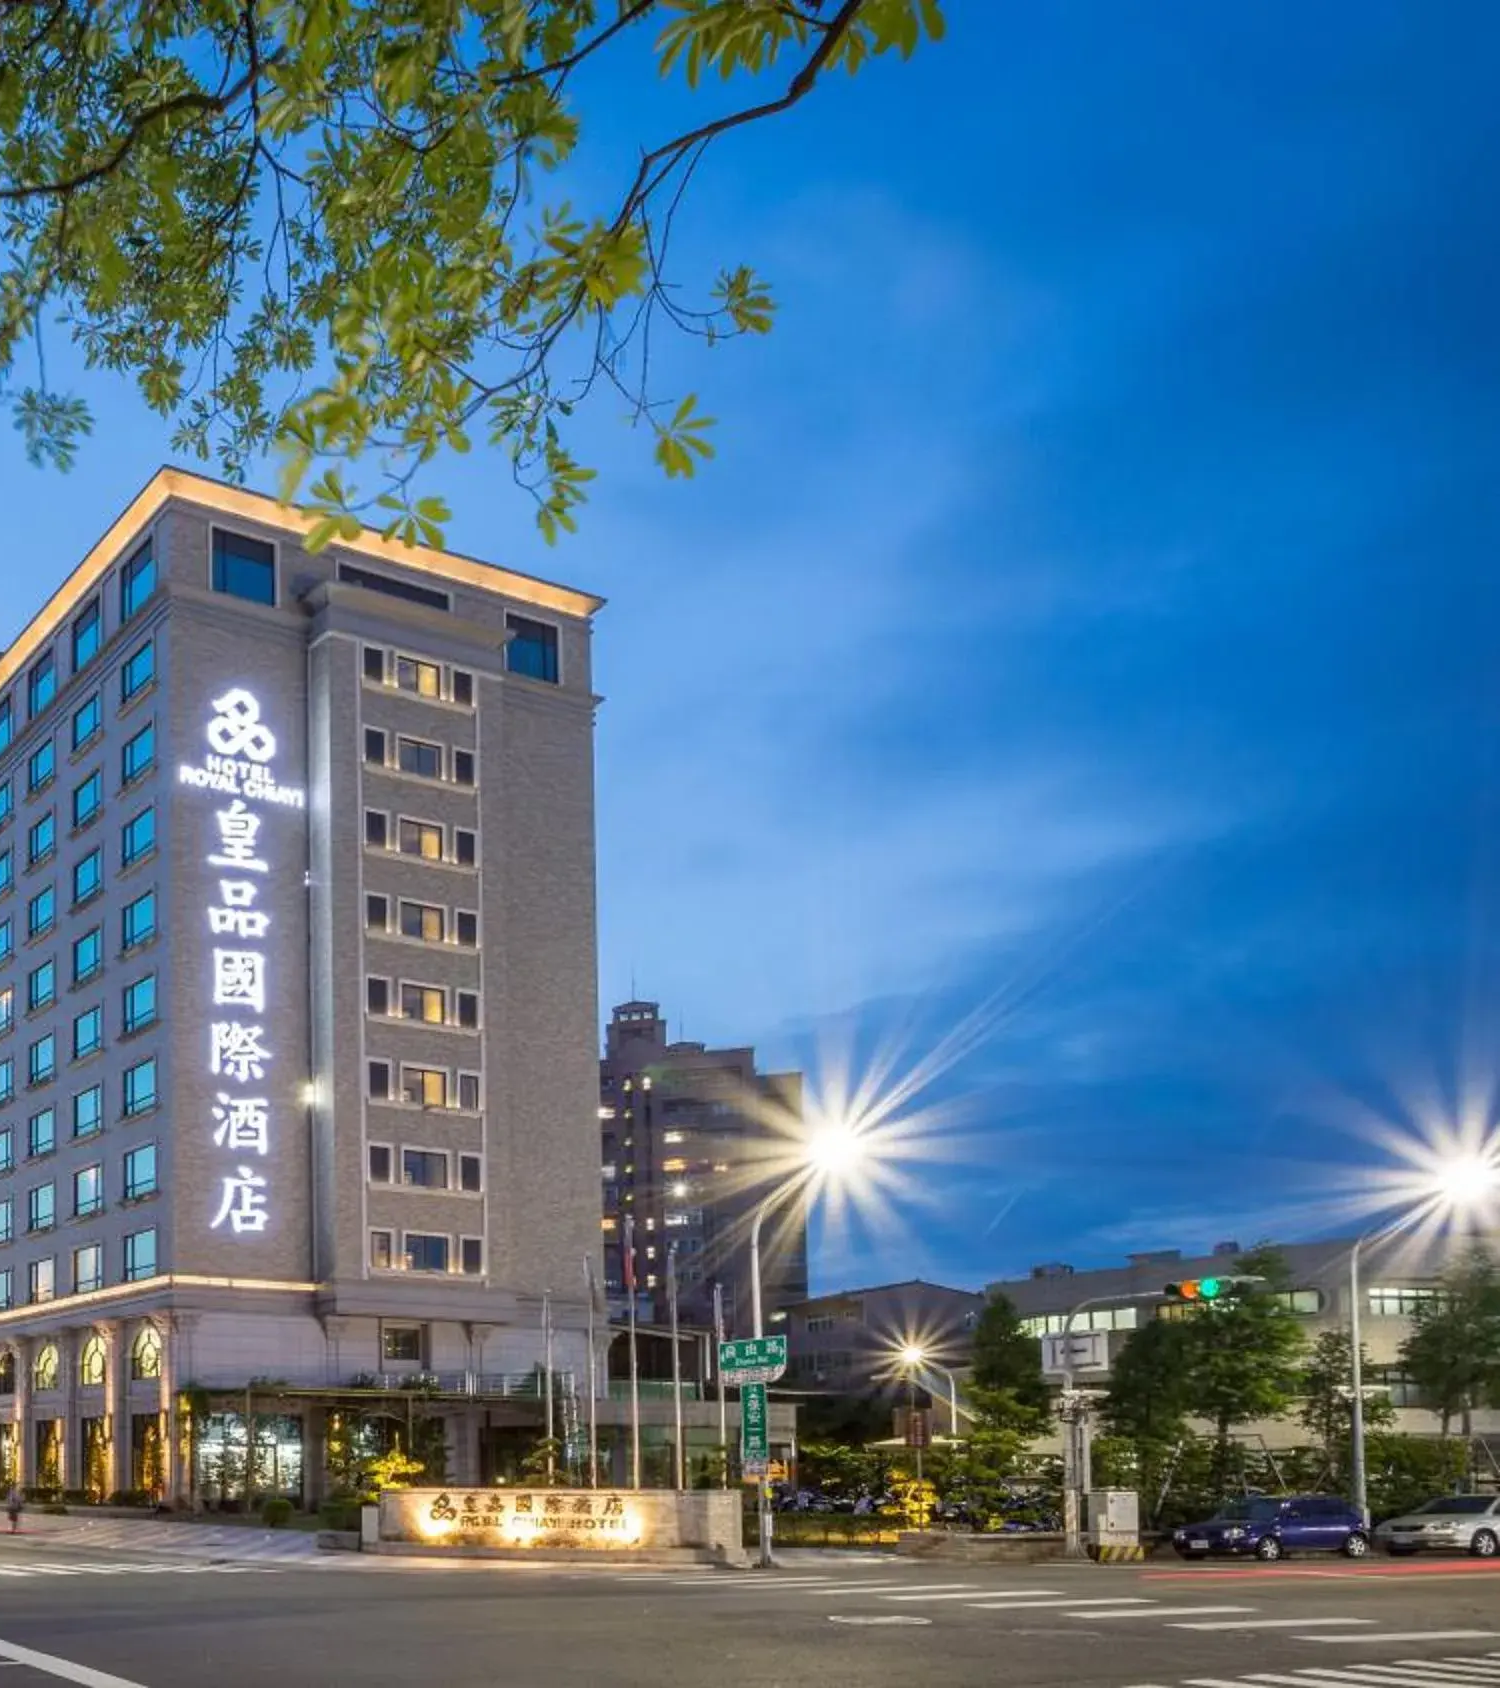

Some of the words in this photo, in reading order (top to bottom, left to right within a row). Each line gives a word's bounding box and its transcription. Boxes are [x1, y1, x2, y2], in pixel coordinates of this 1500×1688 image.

[179, 765, 241, 794] ROYAL
[206, 754, 274, 786] HOTEL
[207, 800, 272, 1234] 皇品國際酒店
[461, 1493, 624, 1516] 皇品國際酒店
